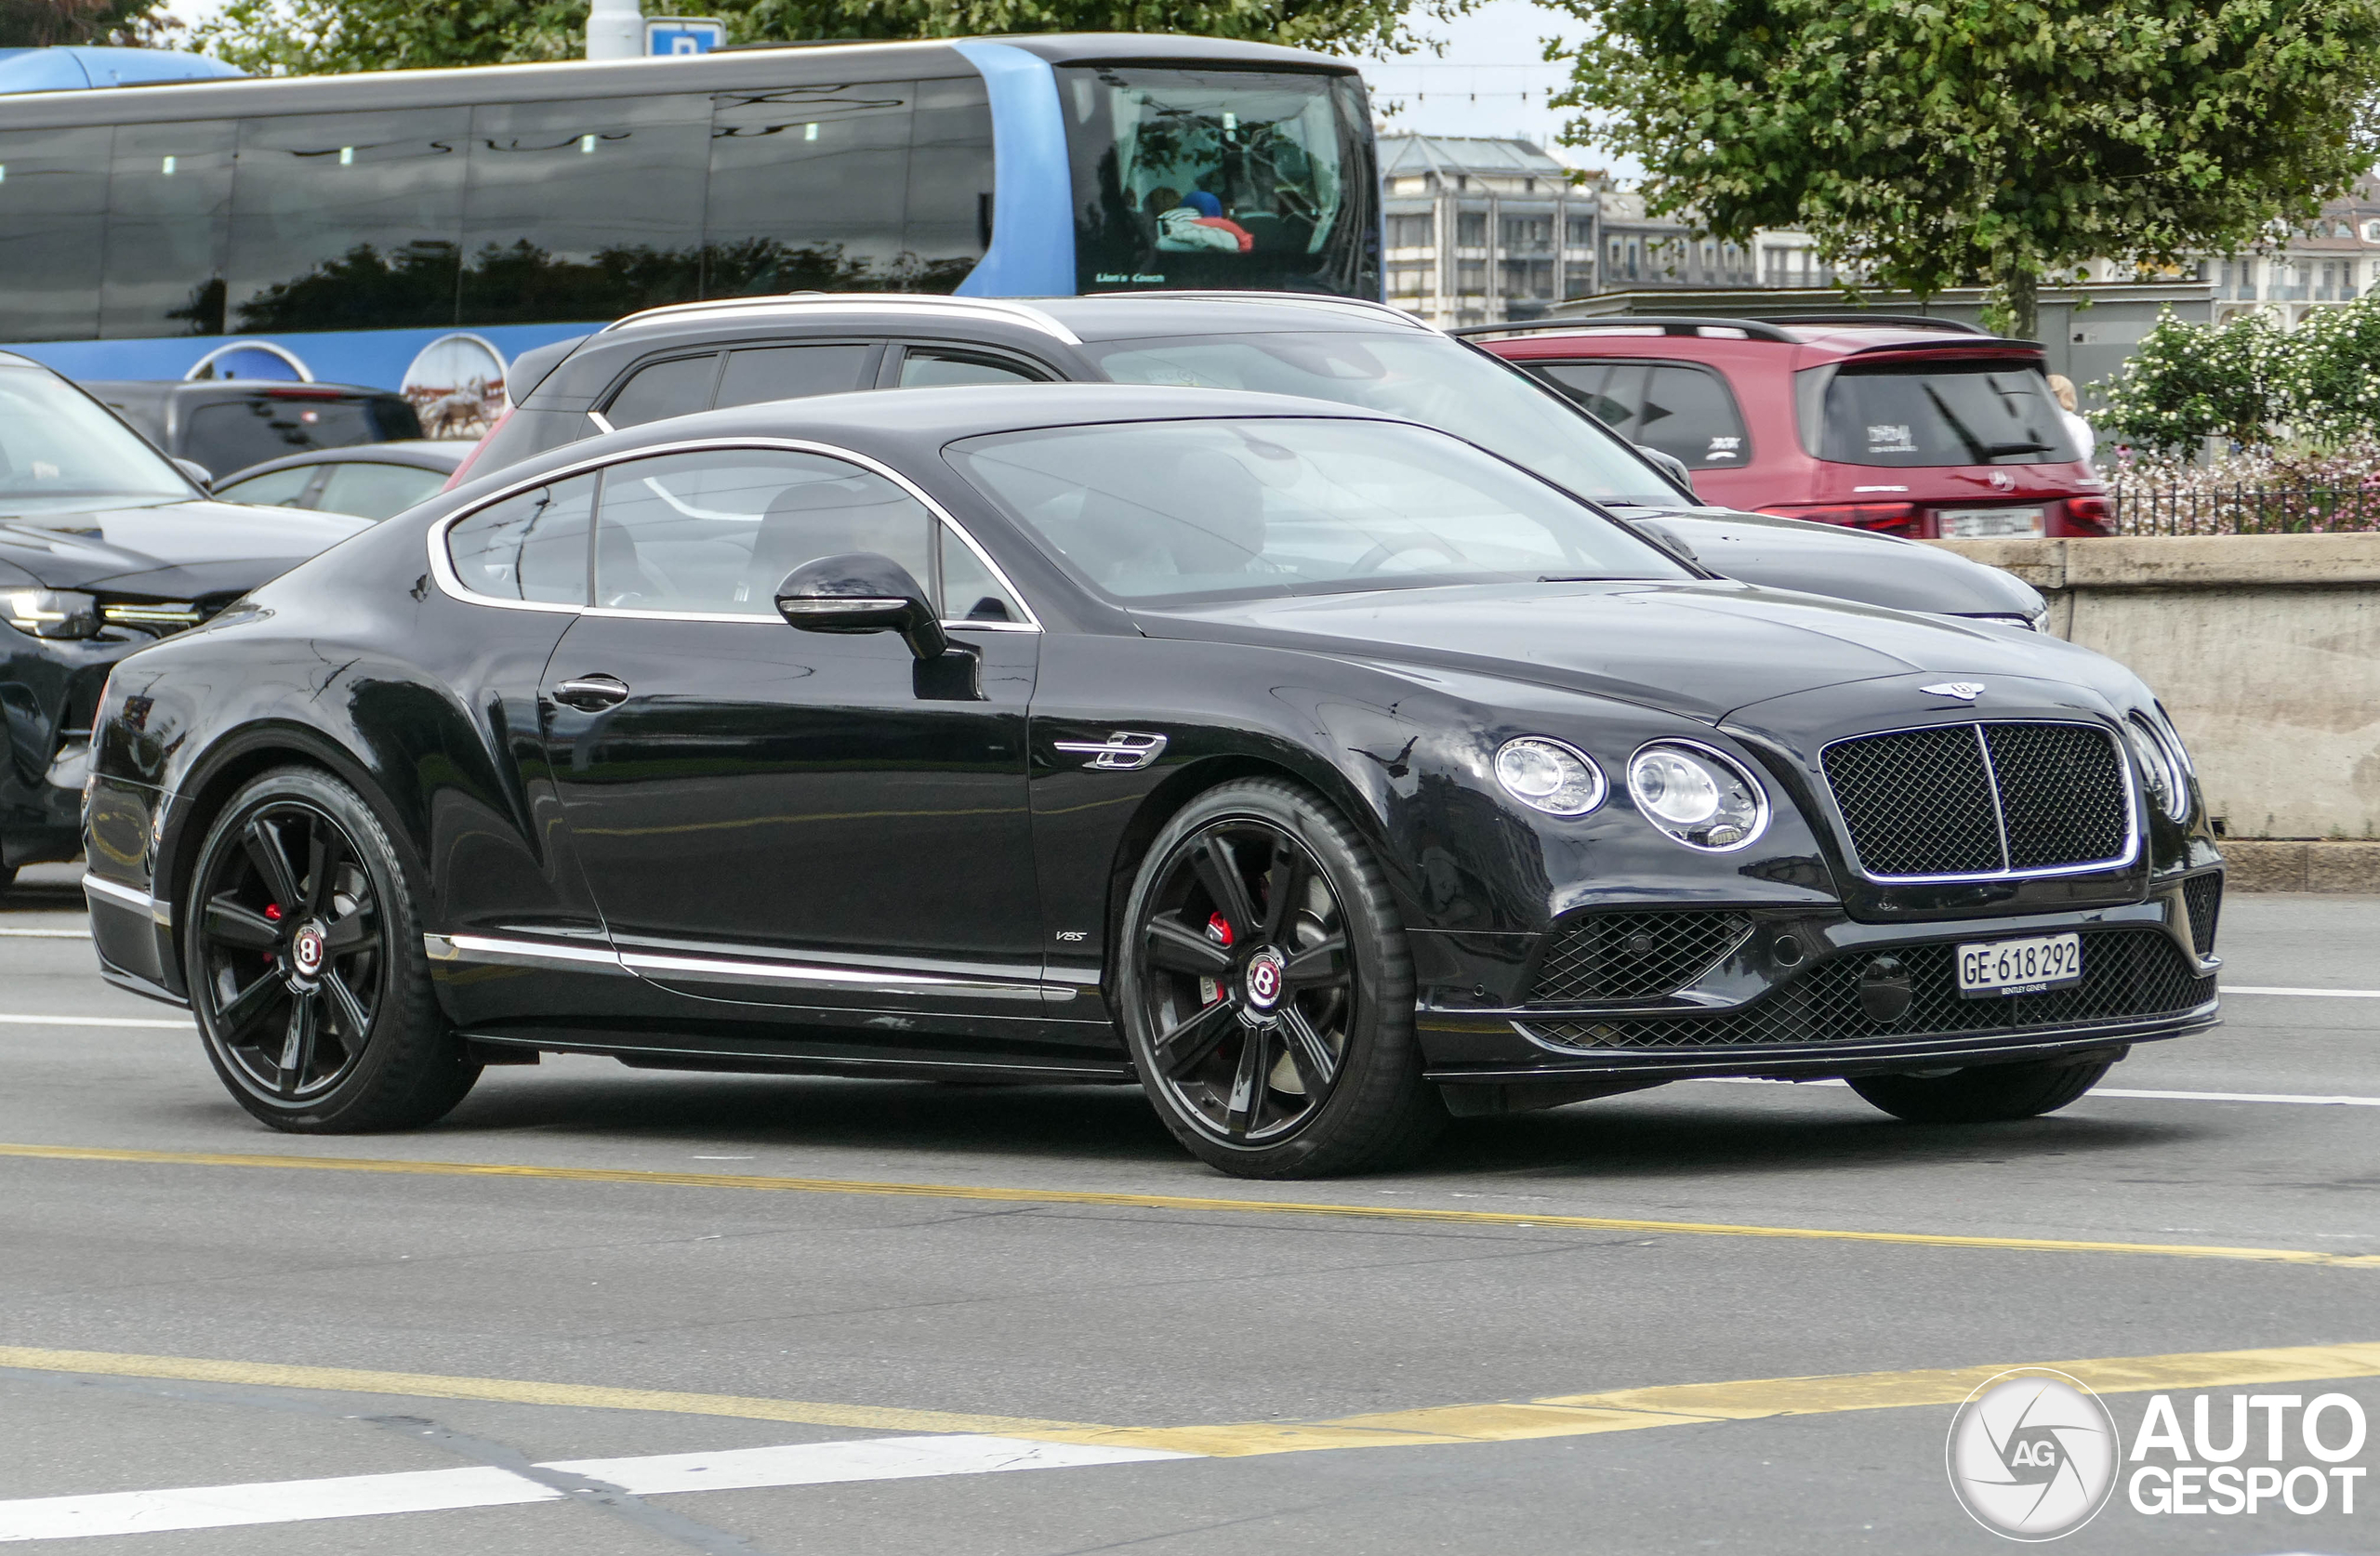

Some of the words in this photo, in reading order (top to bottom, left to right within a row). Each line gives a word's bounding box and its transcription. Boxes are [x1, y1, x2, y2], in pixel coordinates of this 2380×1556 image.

[1056, 930, 1088, 942] V8S
[1254, 967, 1274, 996] B
[2002, 985, 2025, 995] BENTLEY
